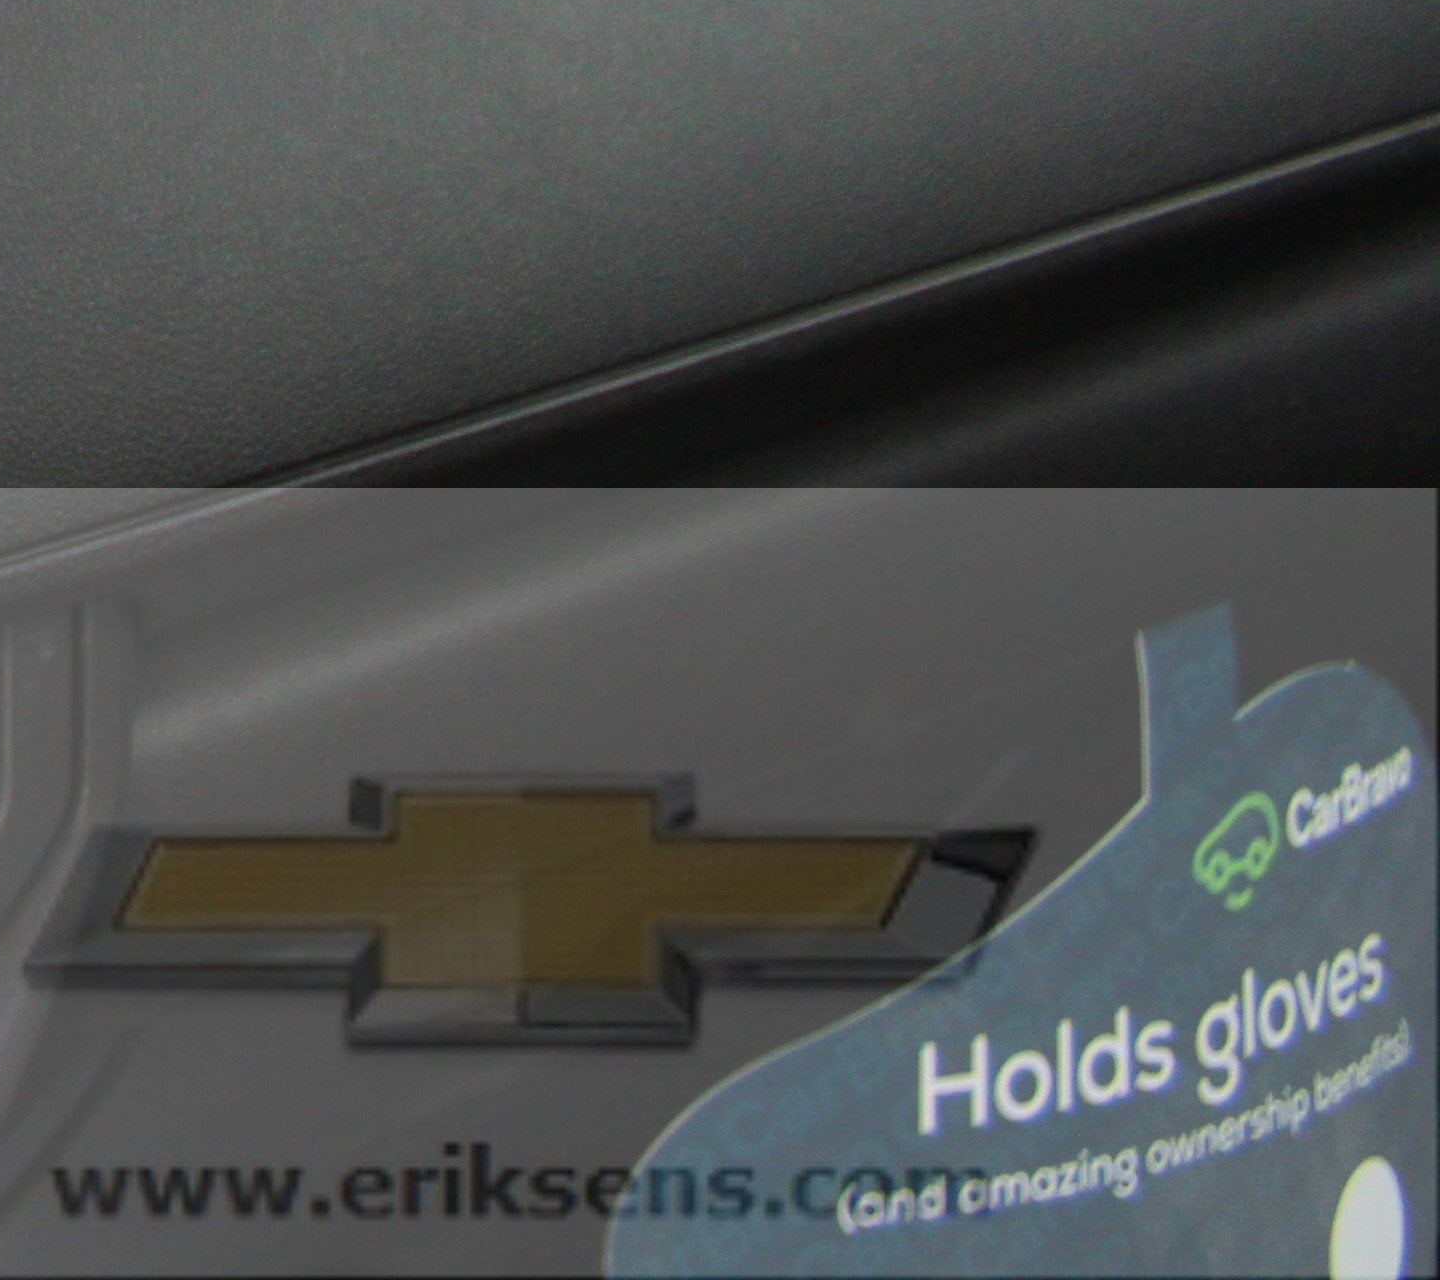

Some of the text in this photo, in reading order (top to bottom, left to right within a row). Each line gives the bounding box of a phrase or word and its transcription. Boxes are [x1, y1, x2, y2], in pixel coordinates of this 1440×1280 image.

[918, 1005, 1178, 1136] Holds
[1195, 931, 1386, 1107] gloves
[836, 1178, 948, 1236] (and
[957, 1146, 1139, 1200] amazing
